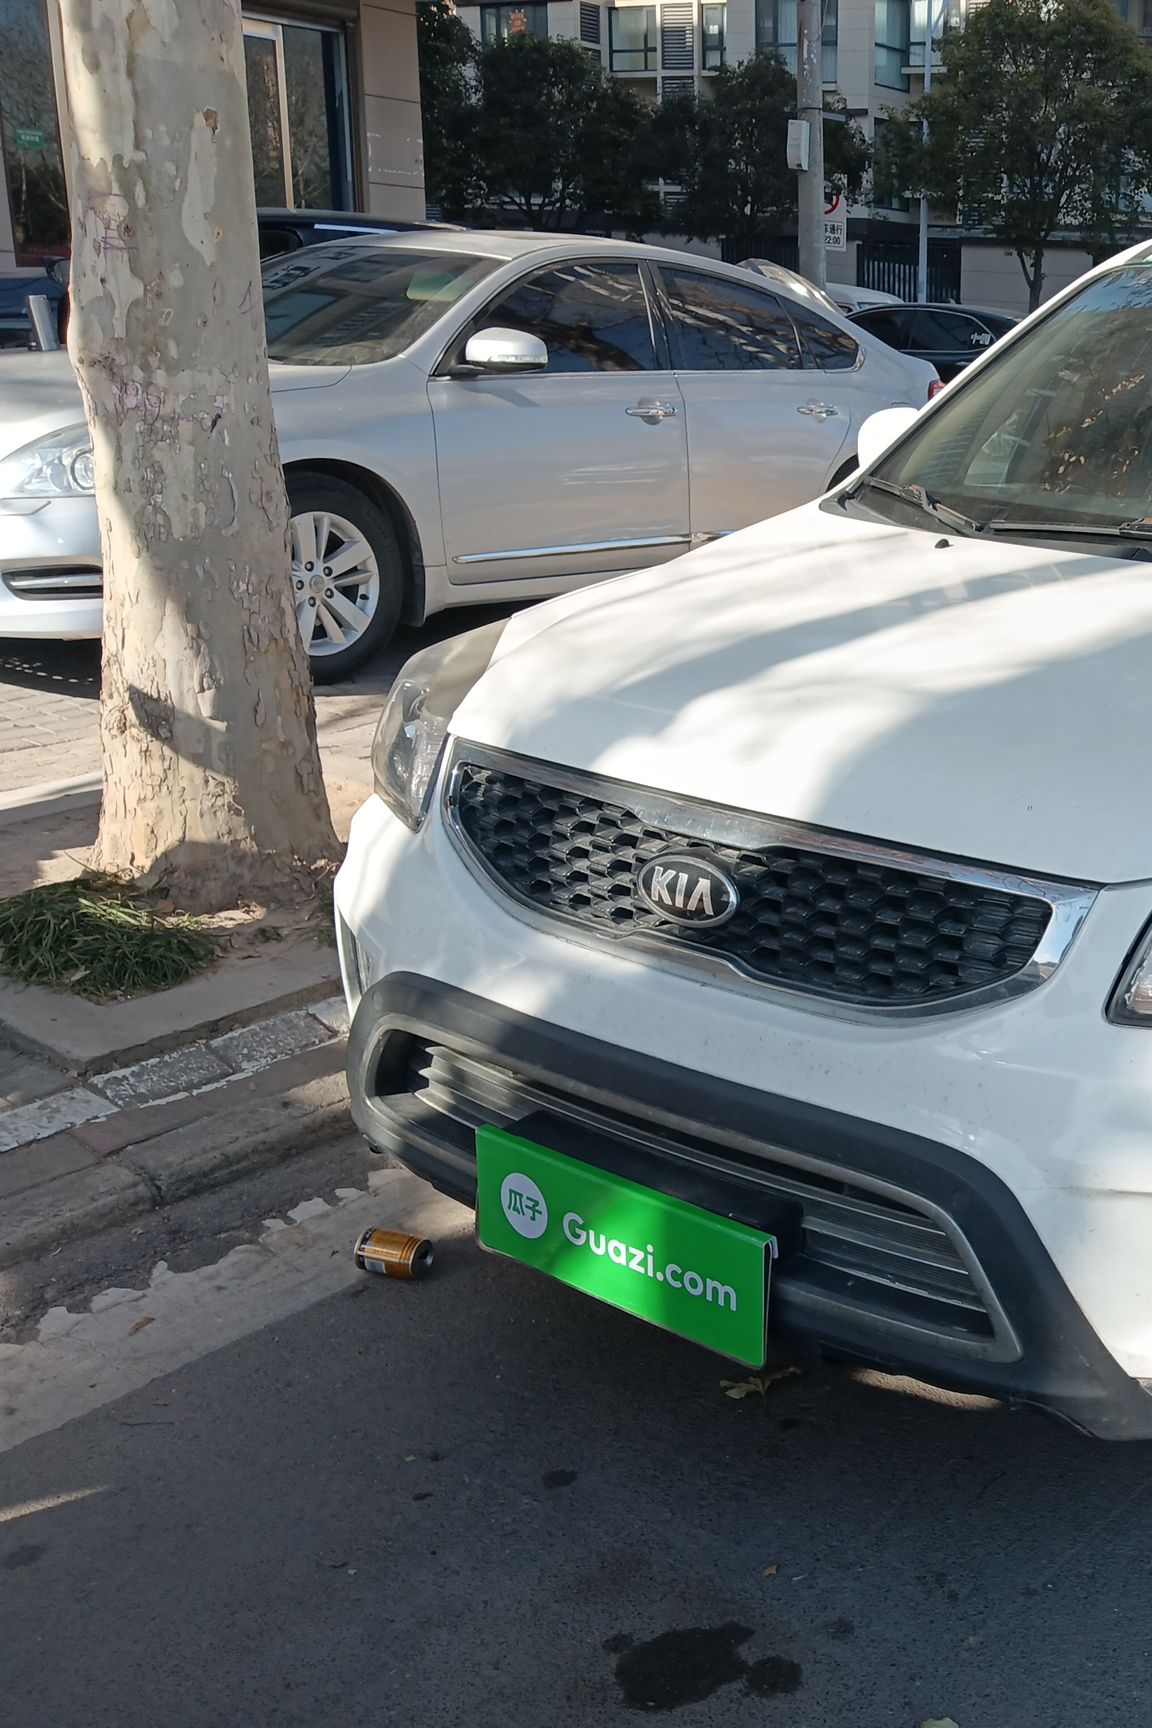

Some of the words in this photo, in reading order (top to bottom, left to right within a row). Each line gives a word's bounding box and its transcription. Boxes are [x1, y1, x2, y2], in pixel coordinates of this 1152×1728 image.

[651, 866, 714, 917] KIA
[507, 1188, 543, 1222] 瓜子
[562, 1212, 737, 1312] Guazi.com
